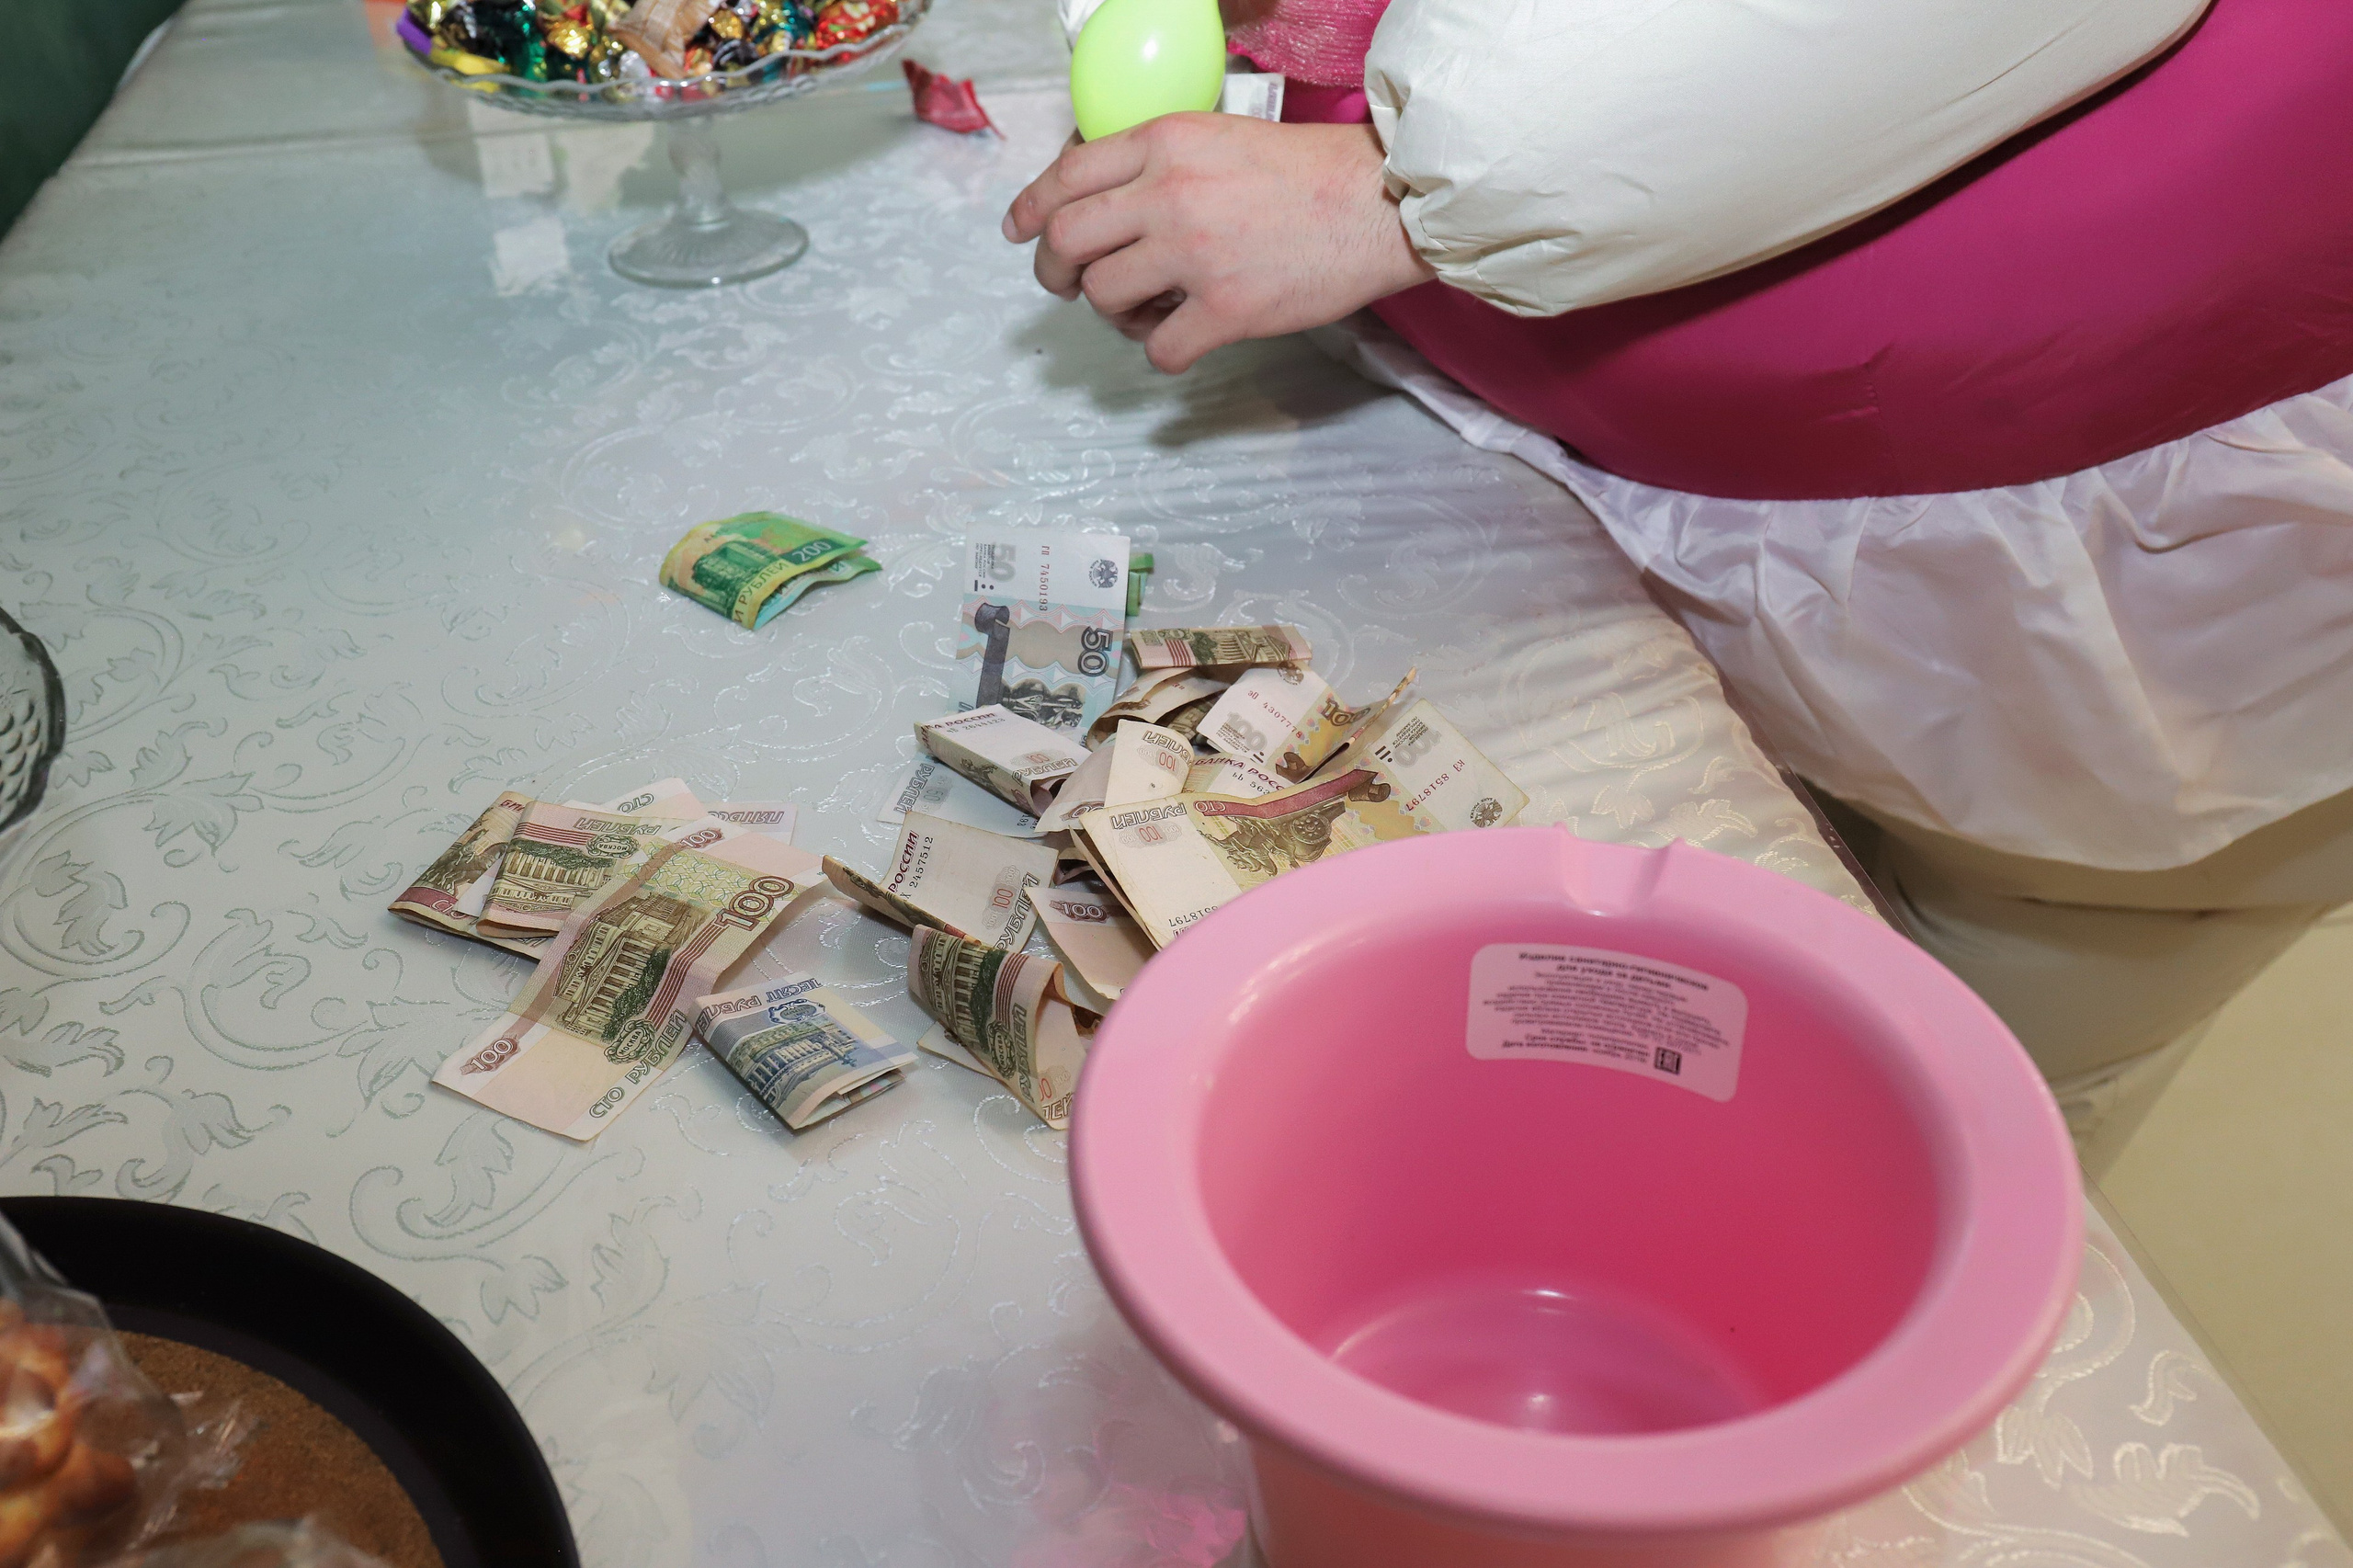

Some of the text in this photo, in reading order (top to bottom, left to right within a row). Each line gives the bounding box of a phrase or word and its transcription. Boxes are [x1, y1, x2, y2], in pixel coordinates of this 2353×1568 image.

[792, 540, 831, 562] 200
[1039, 563, 1050, 612] 7450193
[1077, 626, 1114, 677] 50
[1263, 701, 1302, 740] 4307778
[1159, 752, 1176, 772] 100
[1247, 767, 1285, 790] РОСС
[1405, 773, 1449, 811] 8518797
[1110, 802, 1188, 830] РУБЛЕЙ
[1195, 801, 1226, 812] СТО
[574, 816, 662, 835] РУБЛЕЙ
[680, 829, 722, 848] 100
[1139, 825, 1163, 842] 100
[888, 830, 919, 892] РОССИИ
[909, 836, 933, 888] 2457512
[716, 875, 795, 932] 100
[992, 888, 1013, 909] 100
[1061, 903, 1103, 918] 100
[620, 1029, 642, 1054] МОСКВА
[470, 1039, 514, 1071] 100
[588, 1008, 688, 1119] СТО РУБЛЕЙ
